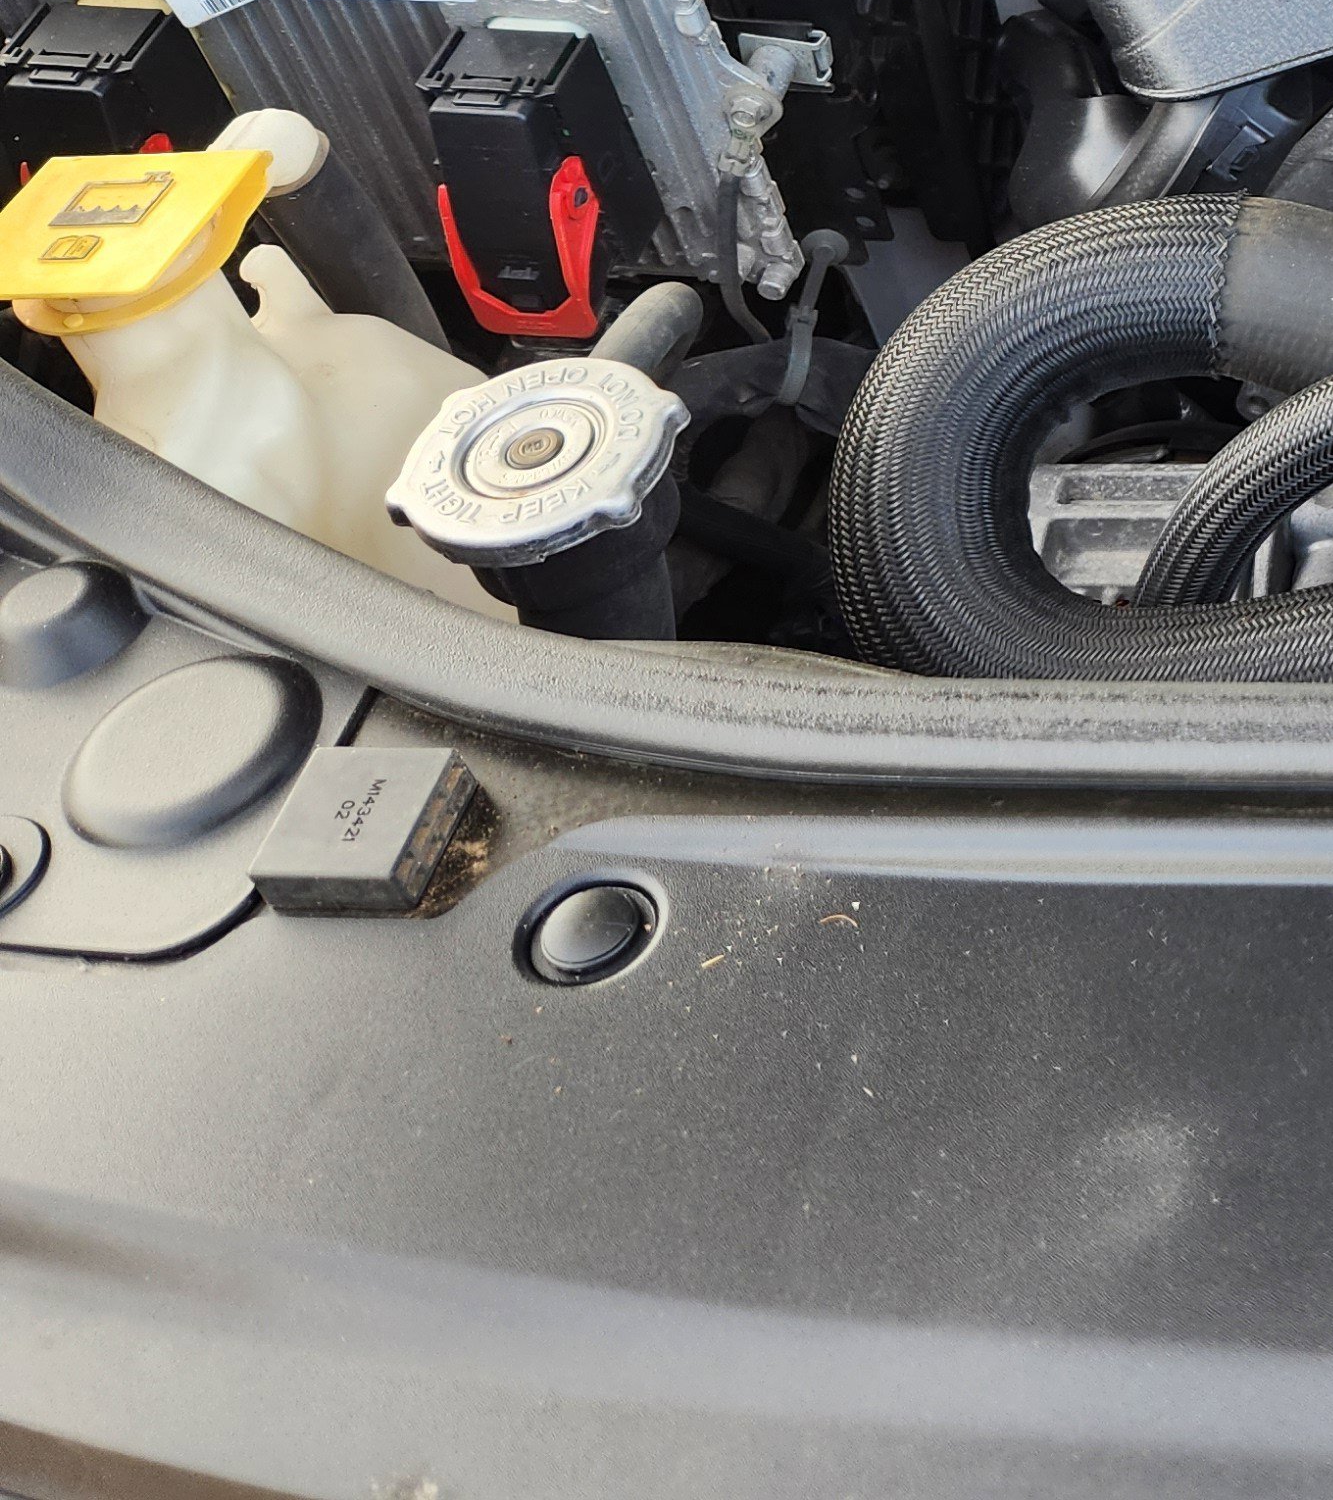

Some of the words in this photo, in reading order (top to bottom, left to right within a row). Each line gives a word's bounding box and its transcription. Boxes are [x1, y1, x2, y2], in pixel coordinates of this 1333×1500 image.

[503, 366, 588, 398] OPEN
[440, 392, 497, 440] HOT
[420, 477, 483, 525] TIGHT
[501, 476, 592, 525] KEEP
[335, 799, 356, 821] 02
[341, 778, 388, 843] M143421
